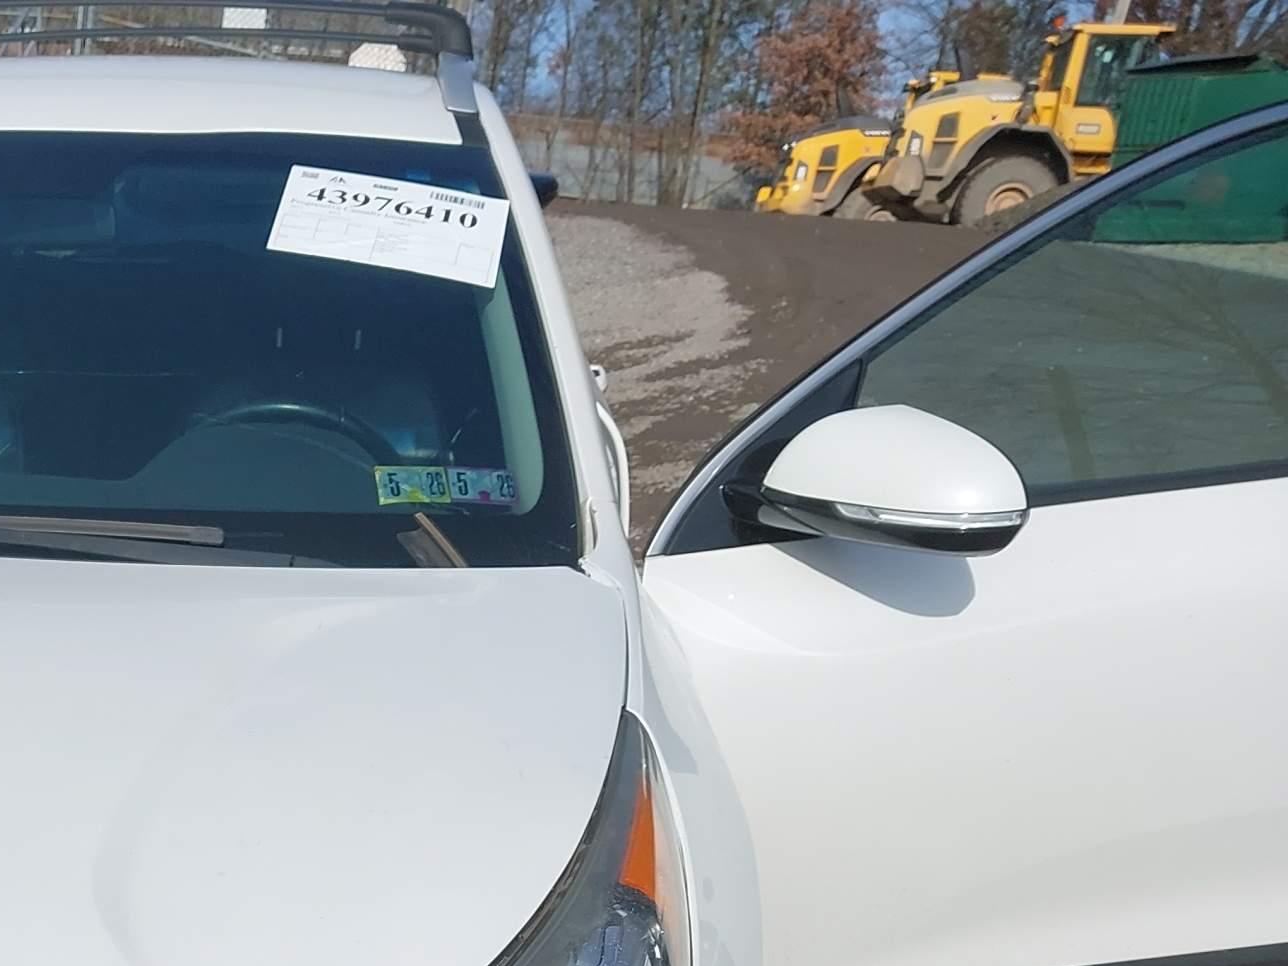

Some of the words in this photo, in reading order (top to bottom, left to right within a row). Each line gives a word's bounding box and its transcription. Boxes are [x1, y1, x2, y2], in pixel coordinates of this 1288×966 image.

[306, 187, 478, 229] 43976410
[387, 472, 401, 497] 5
[426, 471, 447, 496] 26
[456, 472, 470, 496] 5
